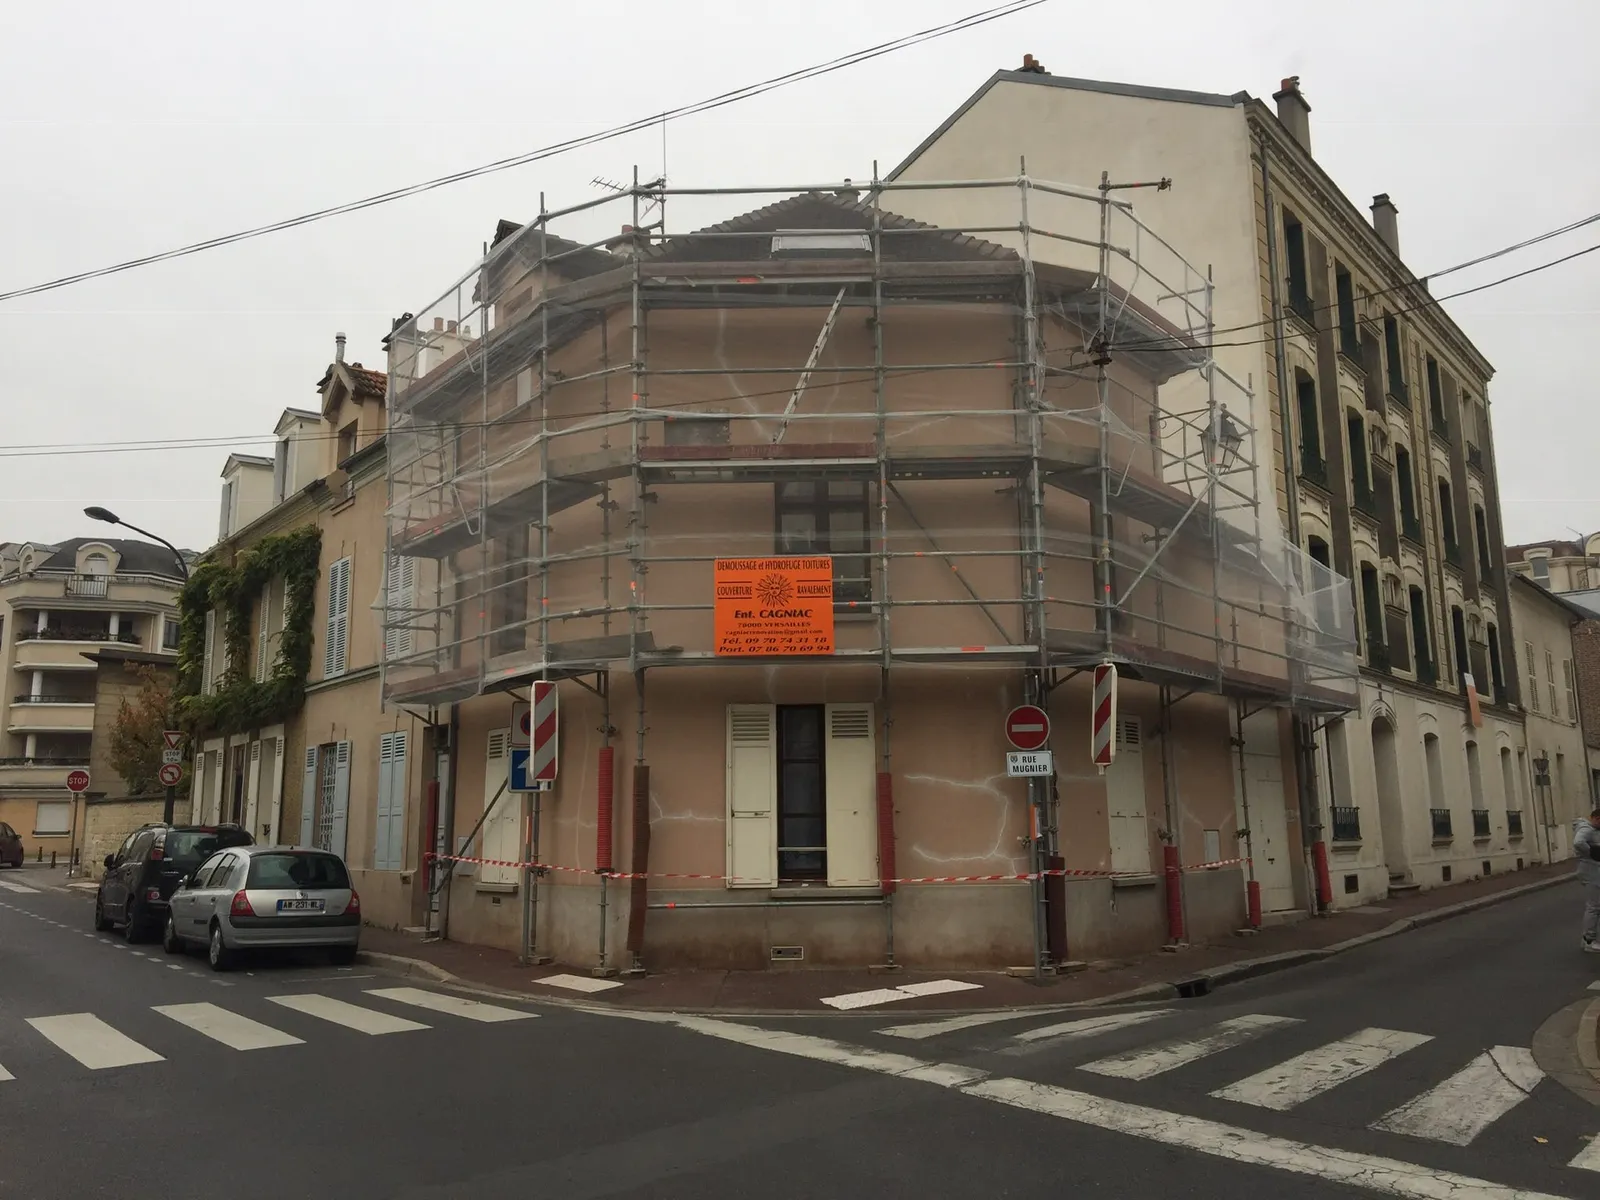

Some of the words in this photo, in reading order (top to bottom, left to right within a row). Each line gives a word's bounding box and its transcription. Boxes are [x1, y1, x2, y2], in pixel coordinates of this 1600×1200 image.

[717, 560, 757, 571] DEMOUSSAGE
[758, 561, 764, 570] et
[765, 559, 801, 570] HYDROFUGE
[802, 559, 831, 569] TOITURES
[717, 586, 752, 596] COUVERTURE
[797, 585, 831, 595] RAVALEMENT
[734, 609, 756, 619] Ent.
[759, 609, 814, 618] CAGNIAC
[722, 637, 742, 645] Tél.
[1022, 755, 1037, 764] RUE
[1012, 764, 1048, 773] MUGNIER
[68, 777, 88, 785] STOP
